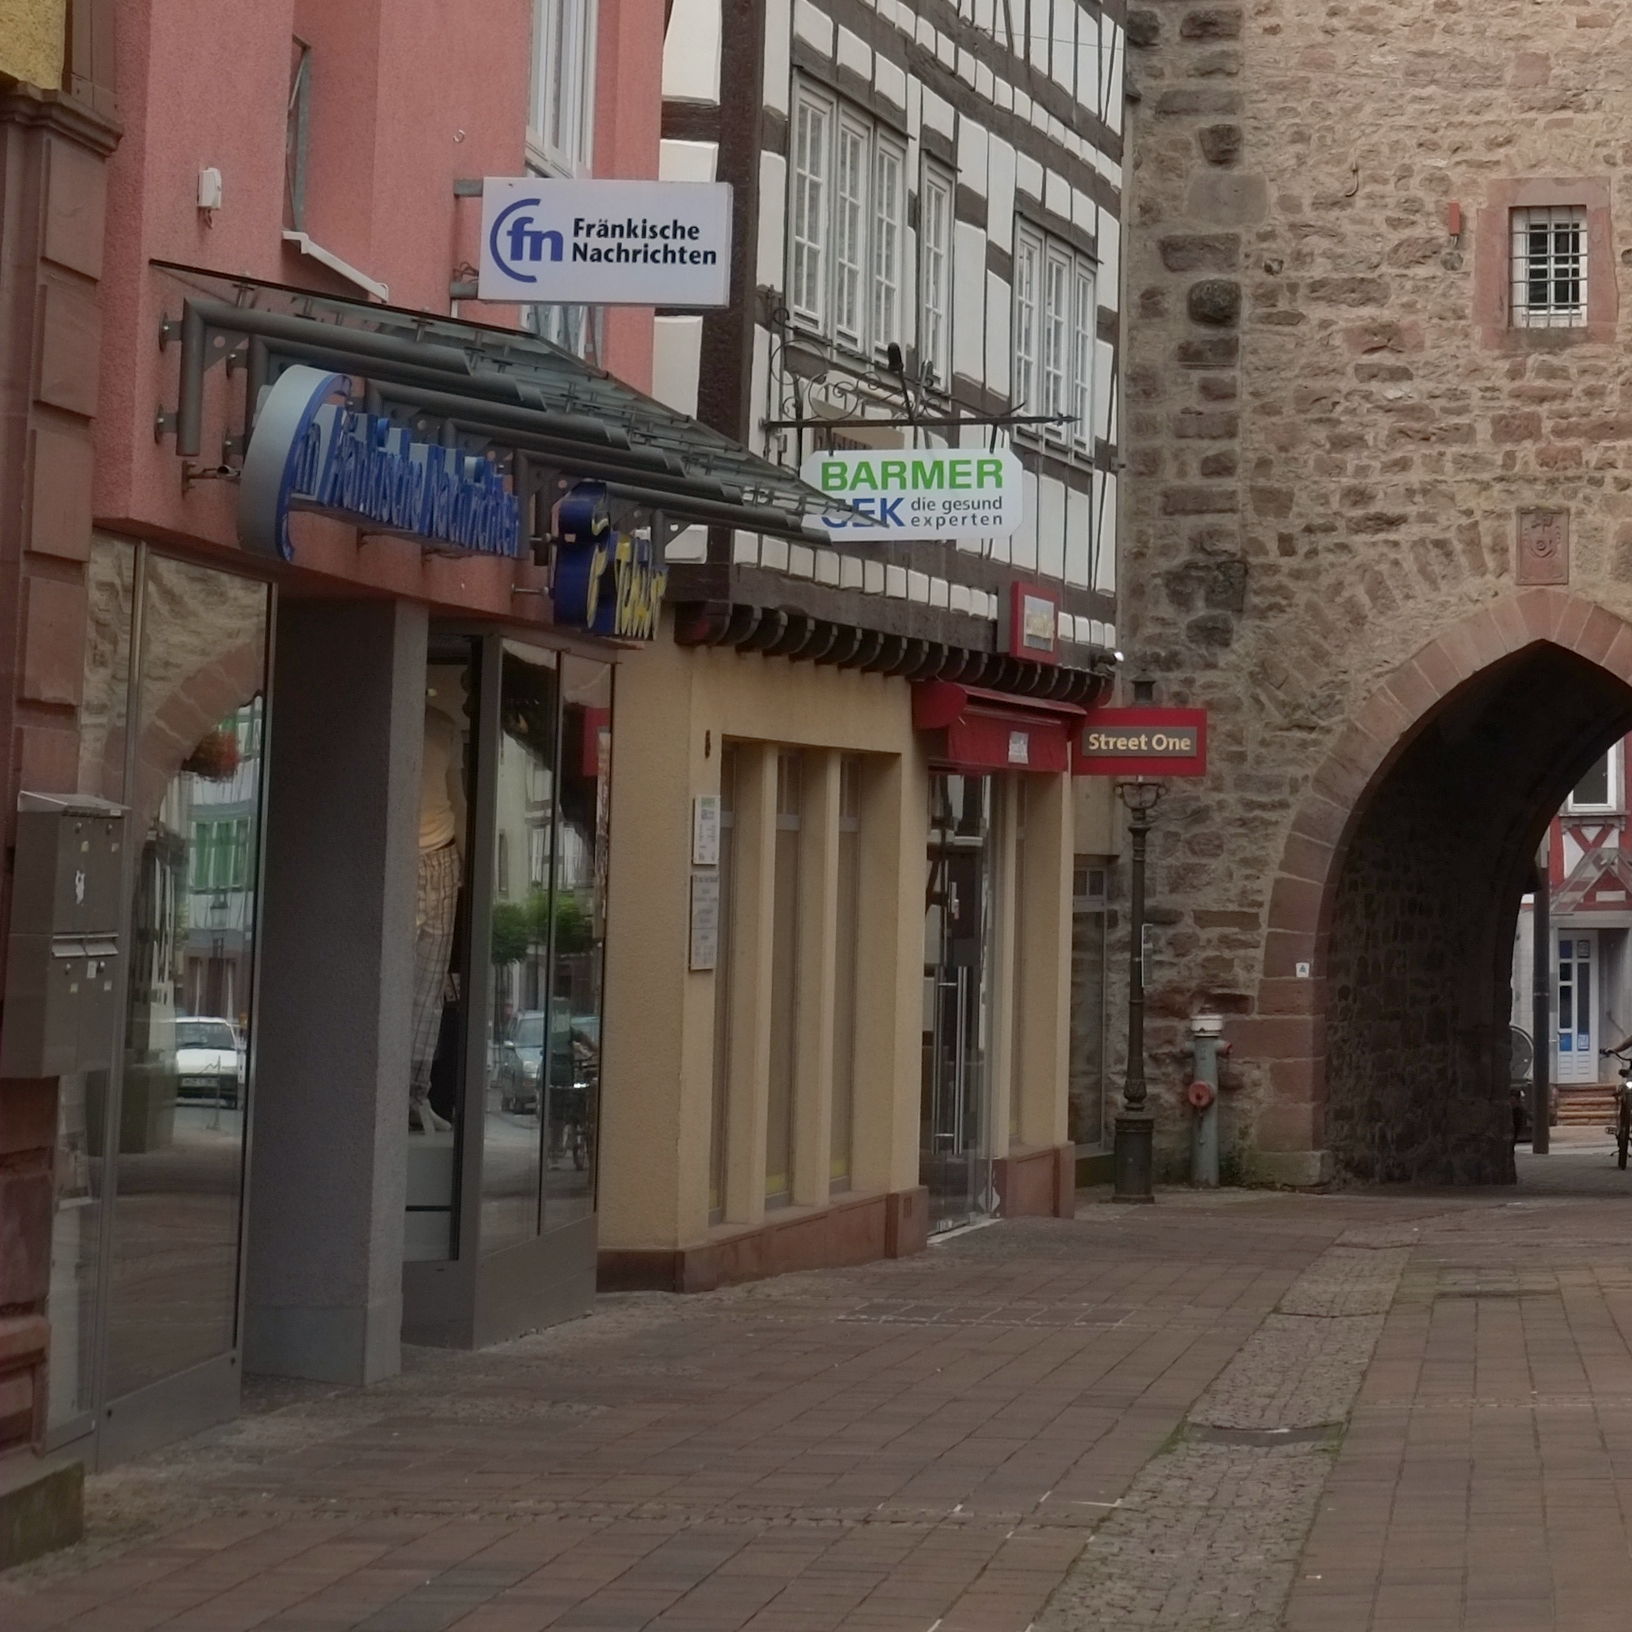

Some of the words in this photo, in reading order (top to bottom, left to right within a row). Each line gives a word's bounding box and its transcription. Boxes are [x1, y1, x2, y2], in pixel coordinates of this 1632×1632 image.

[506, 216, 564, 262] fn
[572, 217, 700, 241] Fränkische
[572, 242, 717, 266] Nachrichten
[821, 458, 1003, 491] BARMER
[911, 496, 936, 511] die
[942, 496, 1002, 514] gesund
[911, 513, 1002, 530] experten
[1088, 733, 1148, 751] Street
[1151, 734, 1191, 751] One
